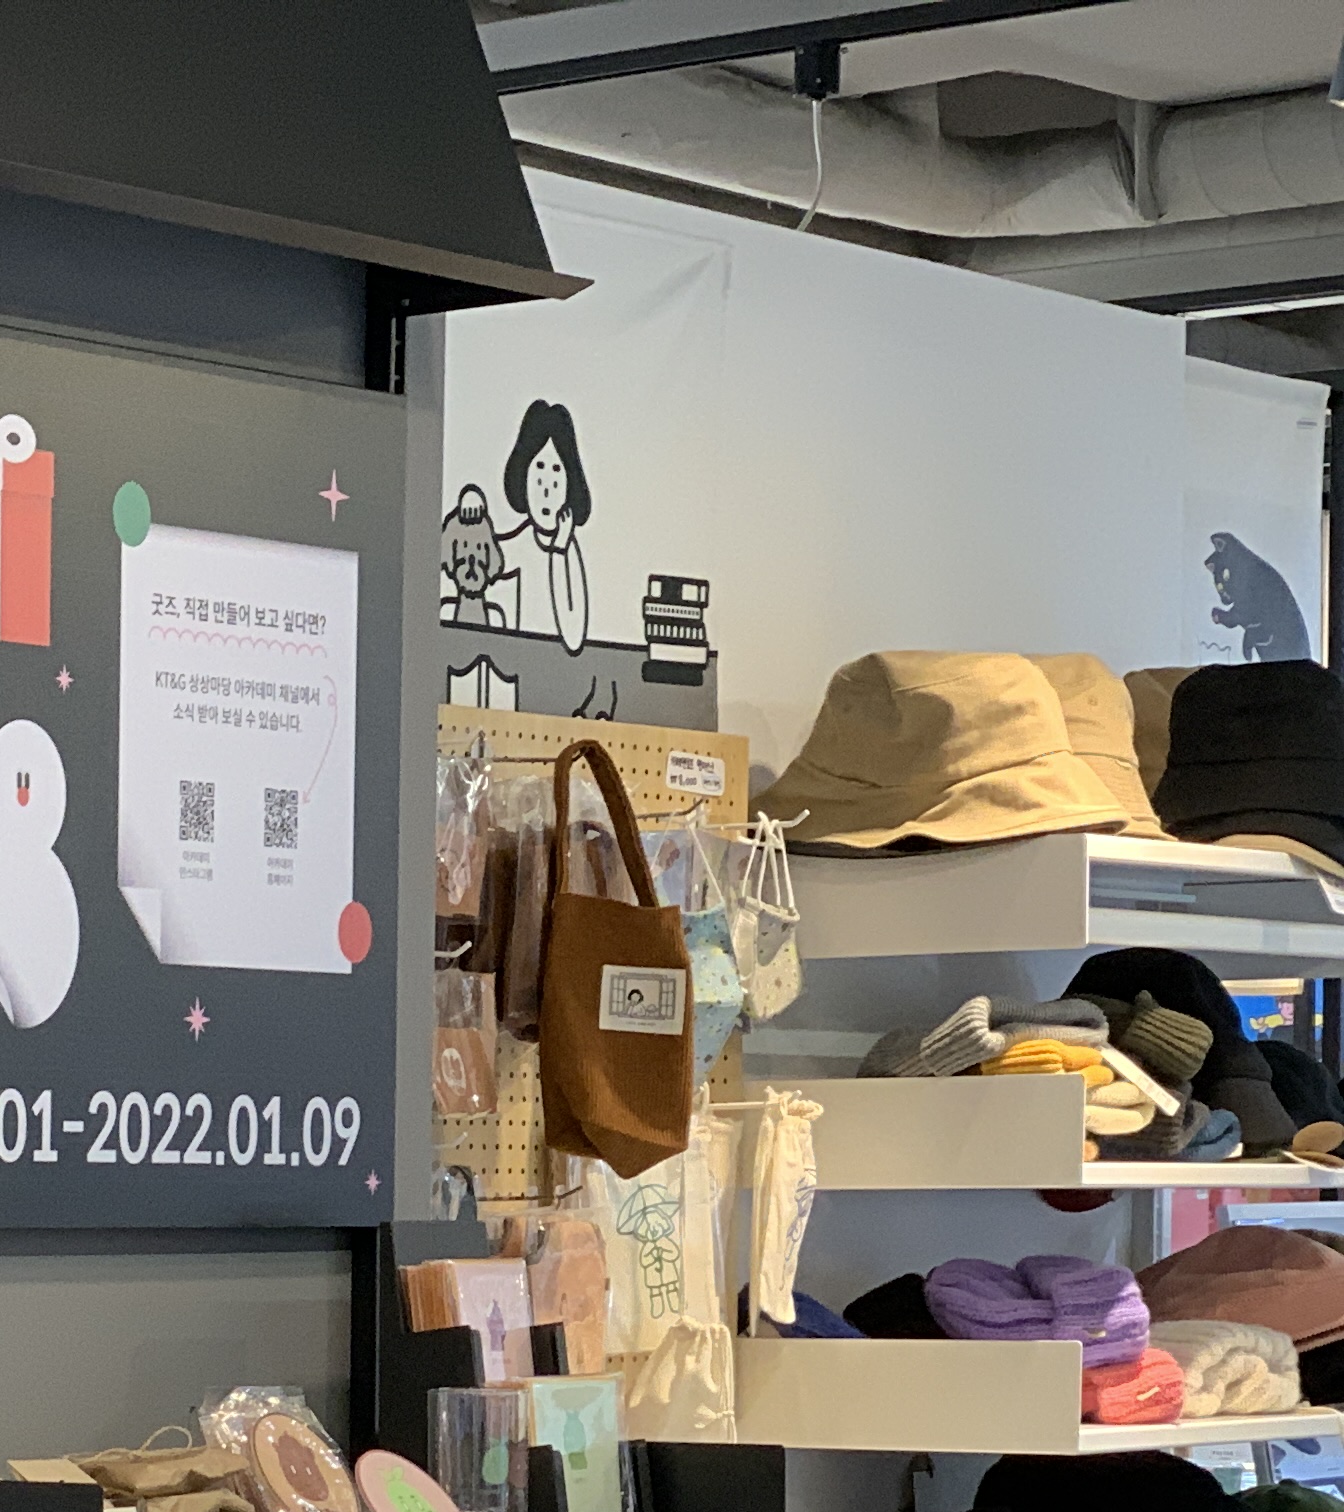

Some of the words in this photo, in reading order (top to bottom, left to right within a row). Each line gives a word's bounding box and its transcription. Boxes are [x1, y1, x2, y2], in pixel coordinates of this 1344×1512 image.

[151, 592, 181, 619] 굿즈,
[183, 596, 210, 622] 직접
[212, 600, 251, 628] 만들어
[253, 606, 280, 629] 보고
[282, 608, 327, 636] 싶다면?
[154, 670, 187, 691] KT&G
[188, 673, 232, 697] 상상마당
[233, 678, 277, 702] 아카데미
[278, 682, 321, 707] 채널에서
[172, 702, 195, 723] 소식
[197, 703, 219, 725] 받아
[221, 707, 243, 728] 보실
[245, 709, 257, 729] 수
